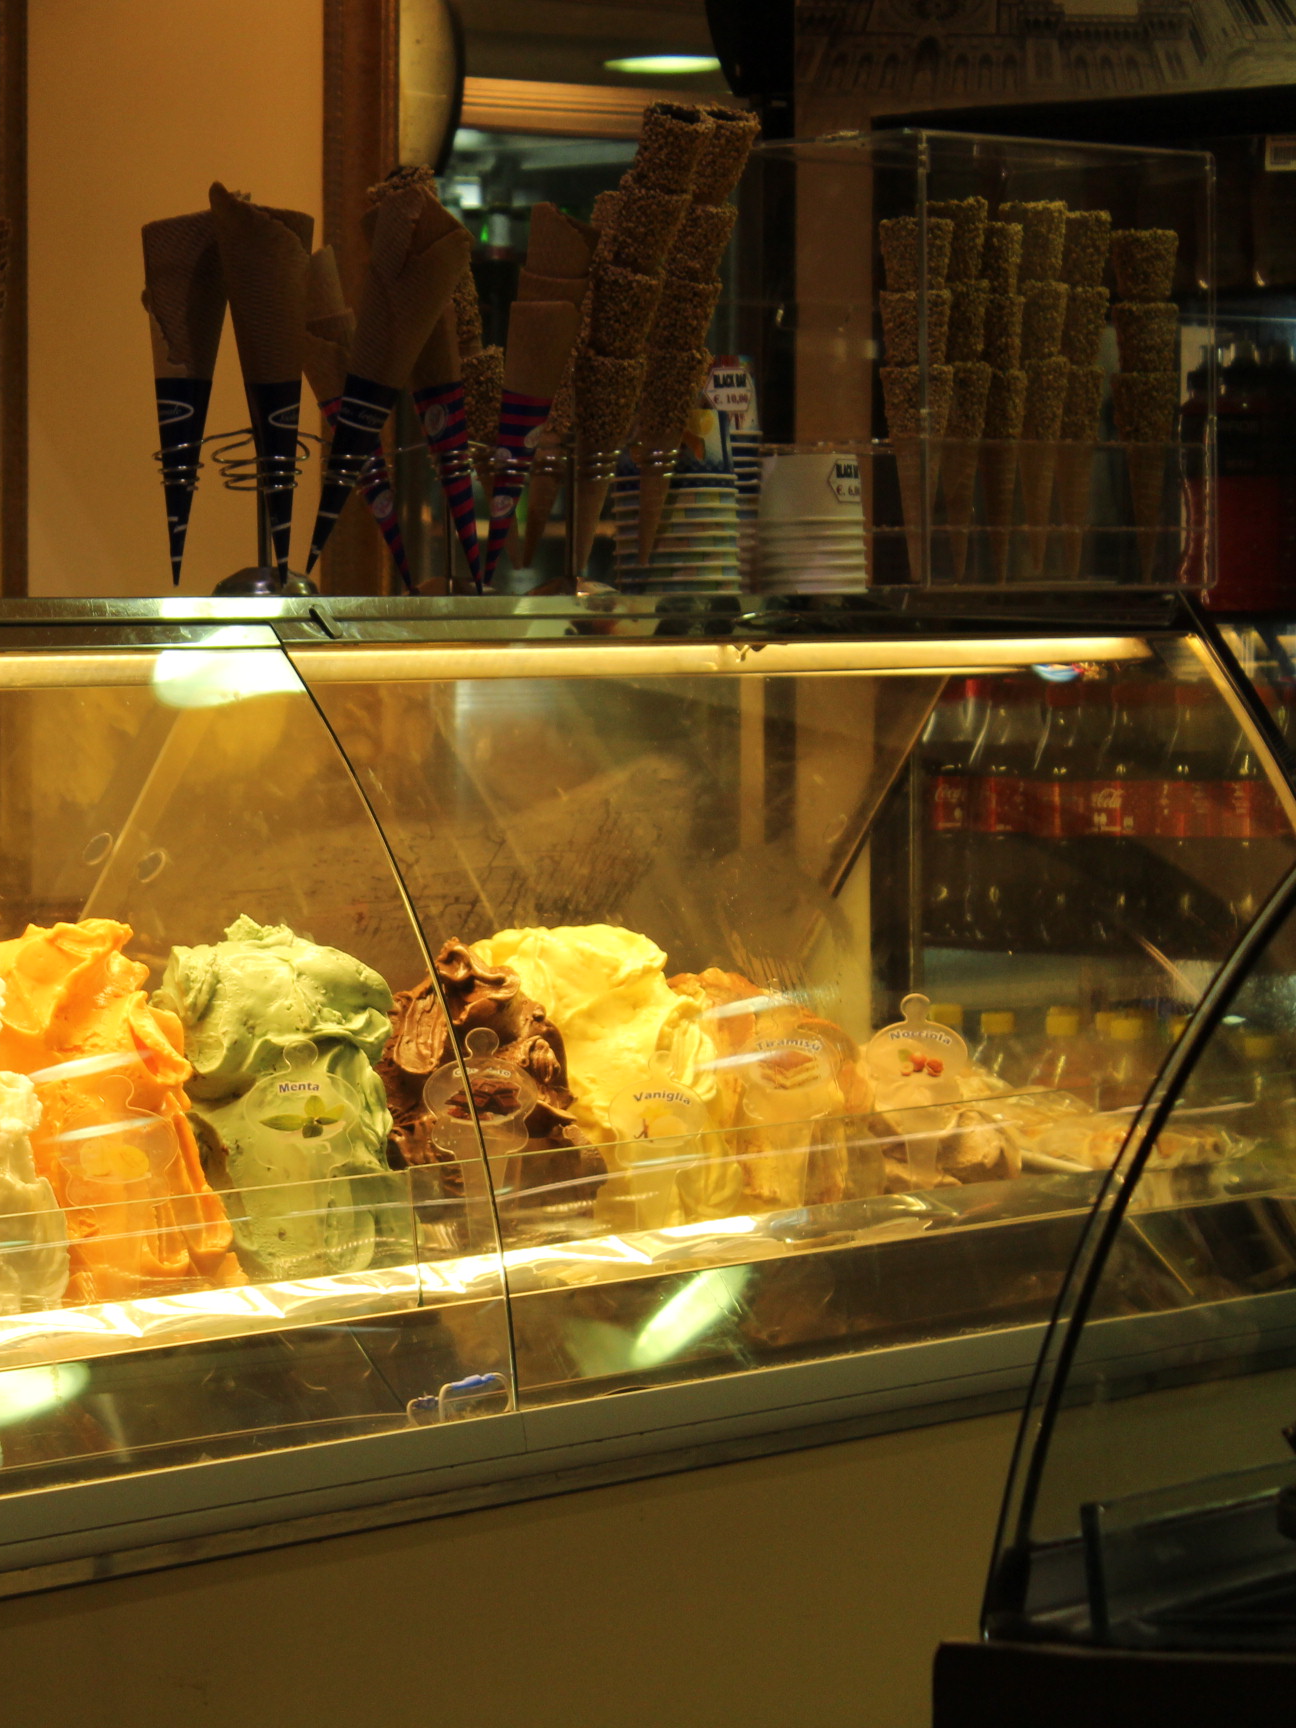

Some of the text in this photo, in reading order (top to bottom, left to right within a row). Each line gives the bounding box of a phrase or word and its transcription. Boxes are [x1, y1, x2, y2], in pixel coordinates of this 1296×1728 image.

[888, 1027, 953, 1046] Nocciola
[278, 1082, 320, 1094] Menta
[632, 1090, 692, 1106] Vaniglia
